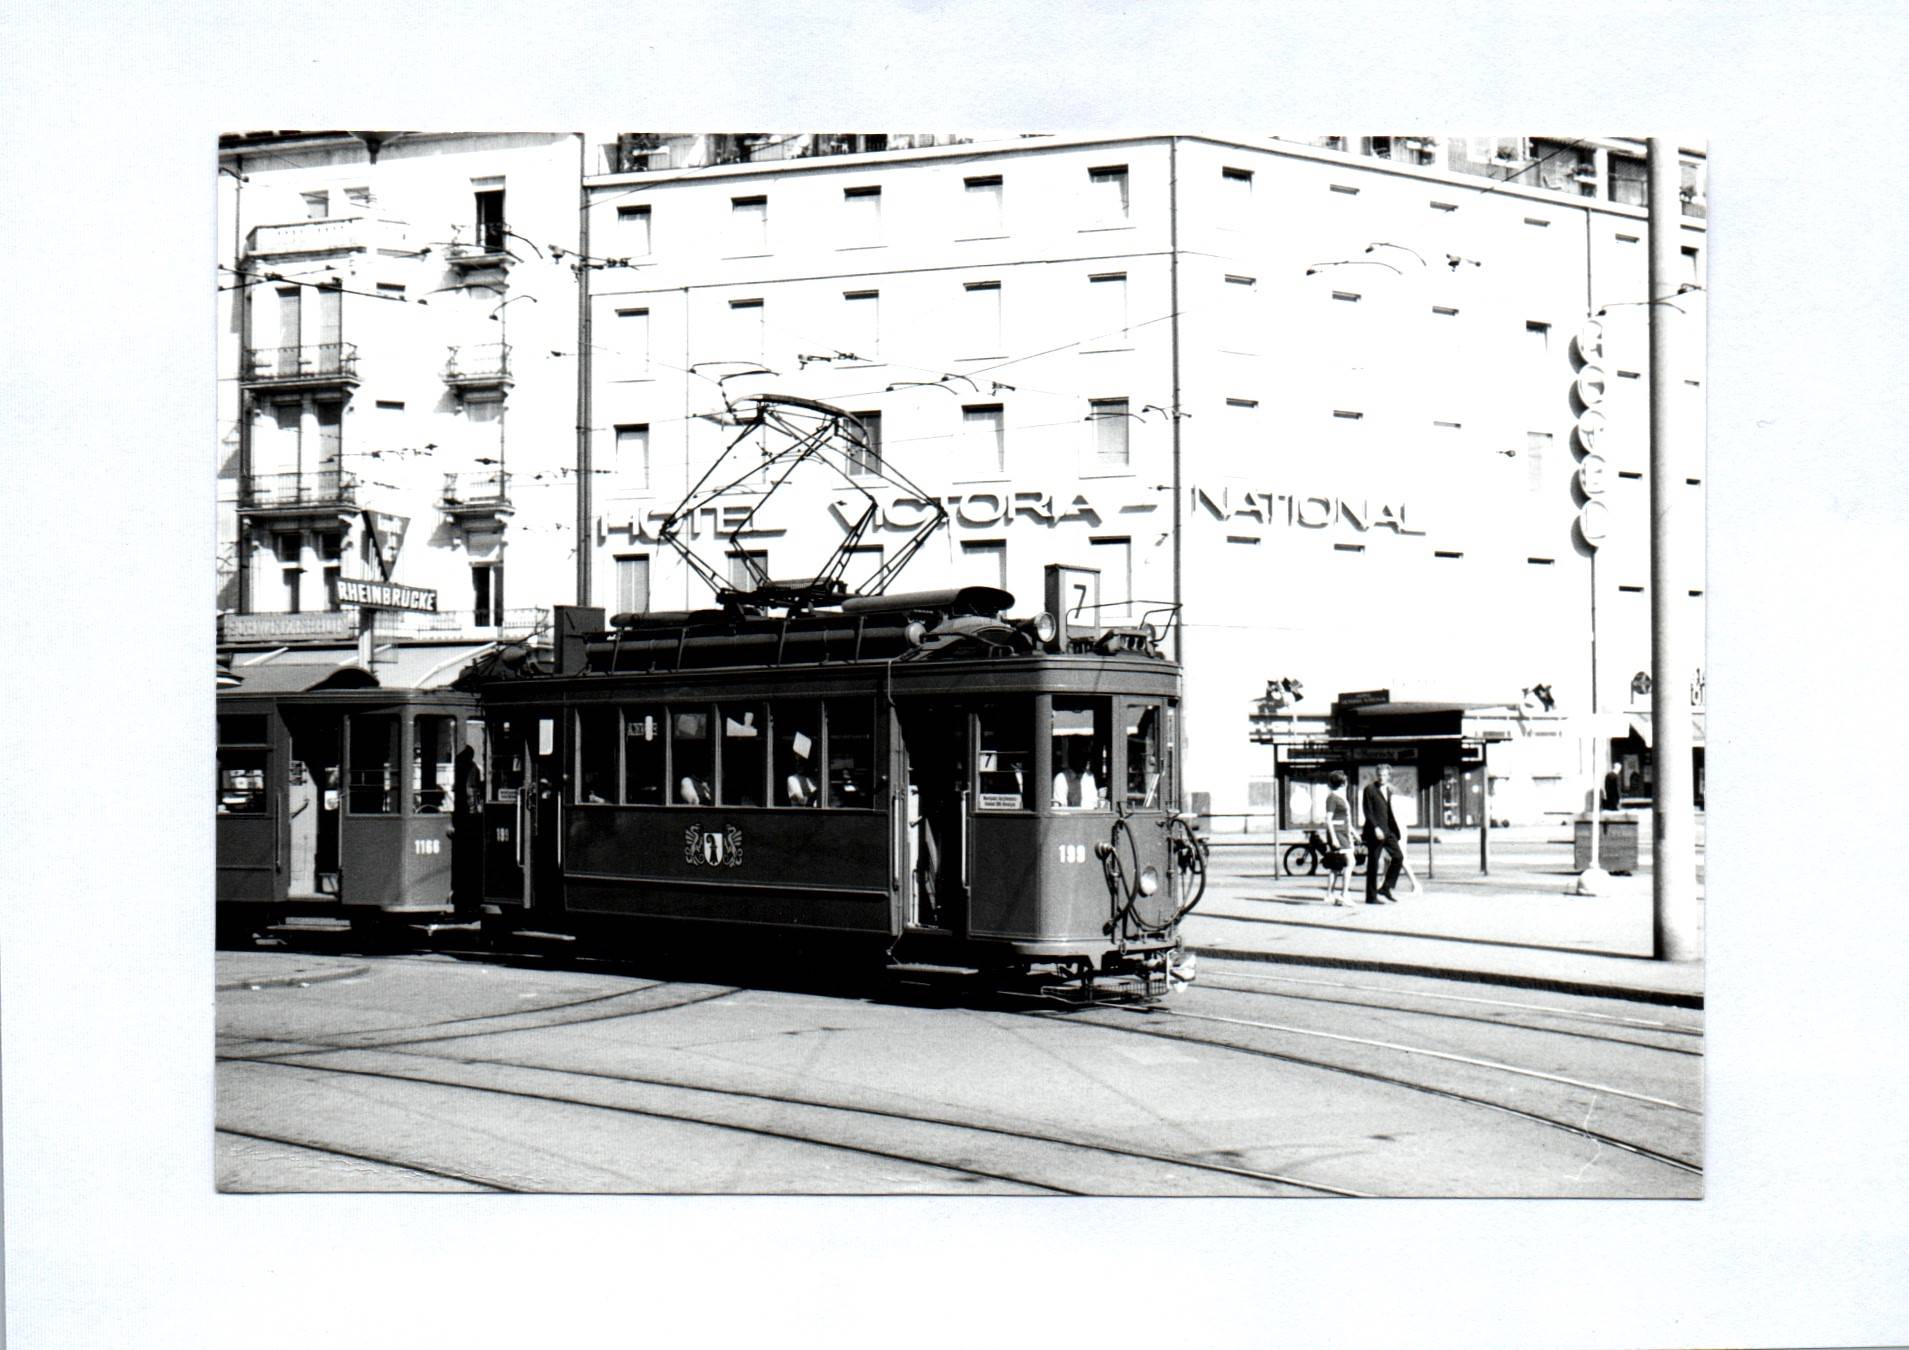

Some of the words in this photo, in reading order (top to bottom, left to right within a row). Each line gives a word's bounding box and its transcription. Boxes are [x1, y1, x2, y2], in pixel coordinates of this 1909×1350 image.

[597, 505, 787, 547] HOTEL
[827, 490, 1102, 534] VICTORIA
[1190, 483, 1427, 536] NATIONAL
[1073, 584, 1087, 619] 7
[985, 752, 992, 768] 7
